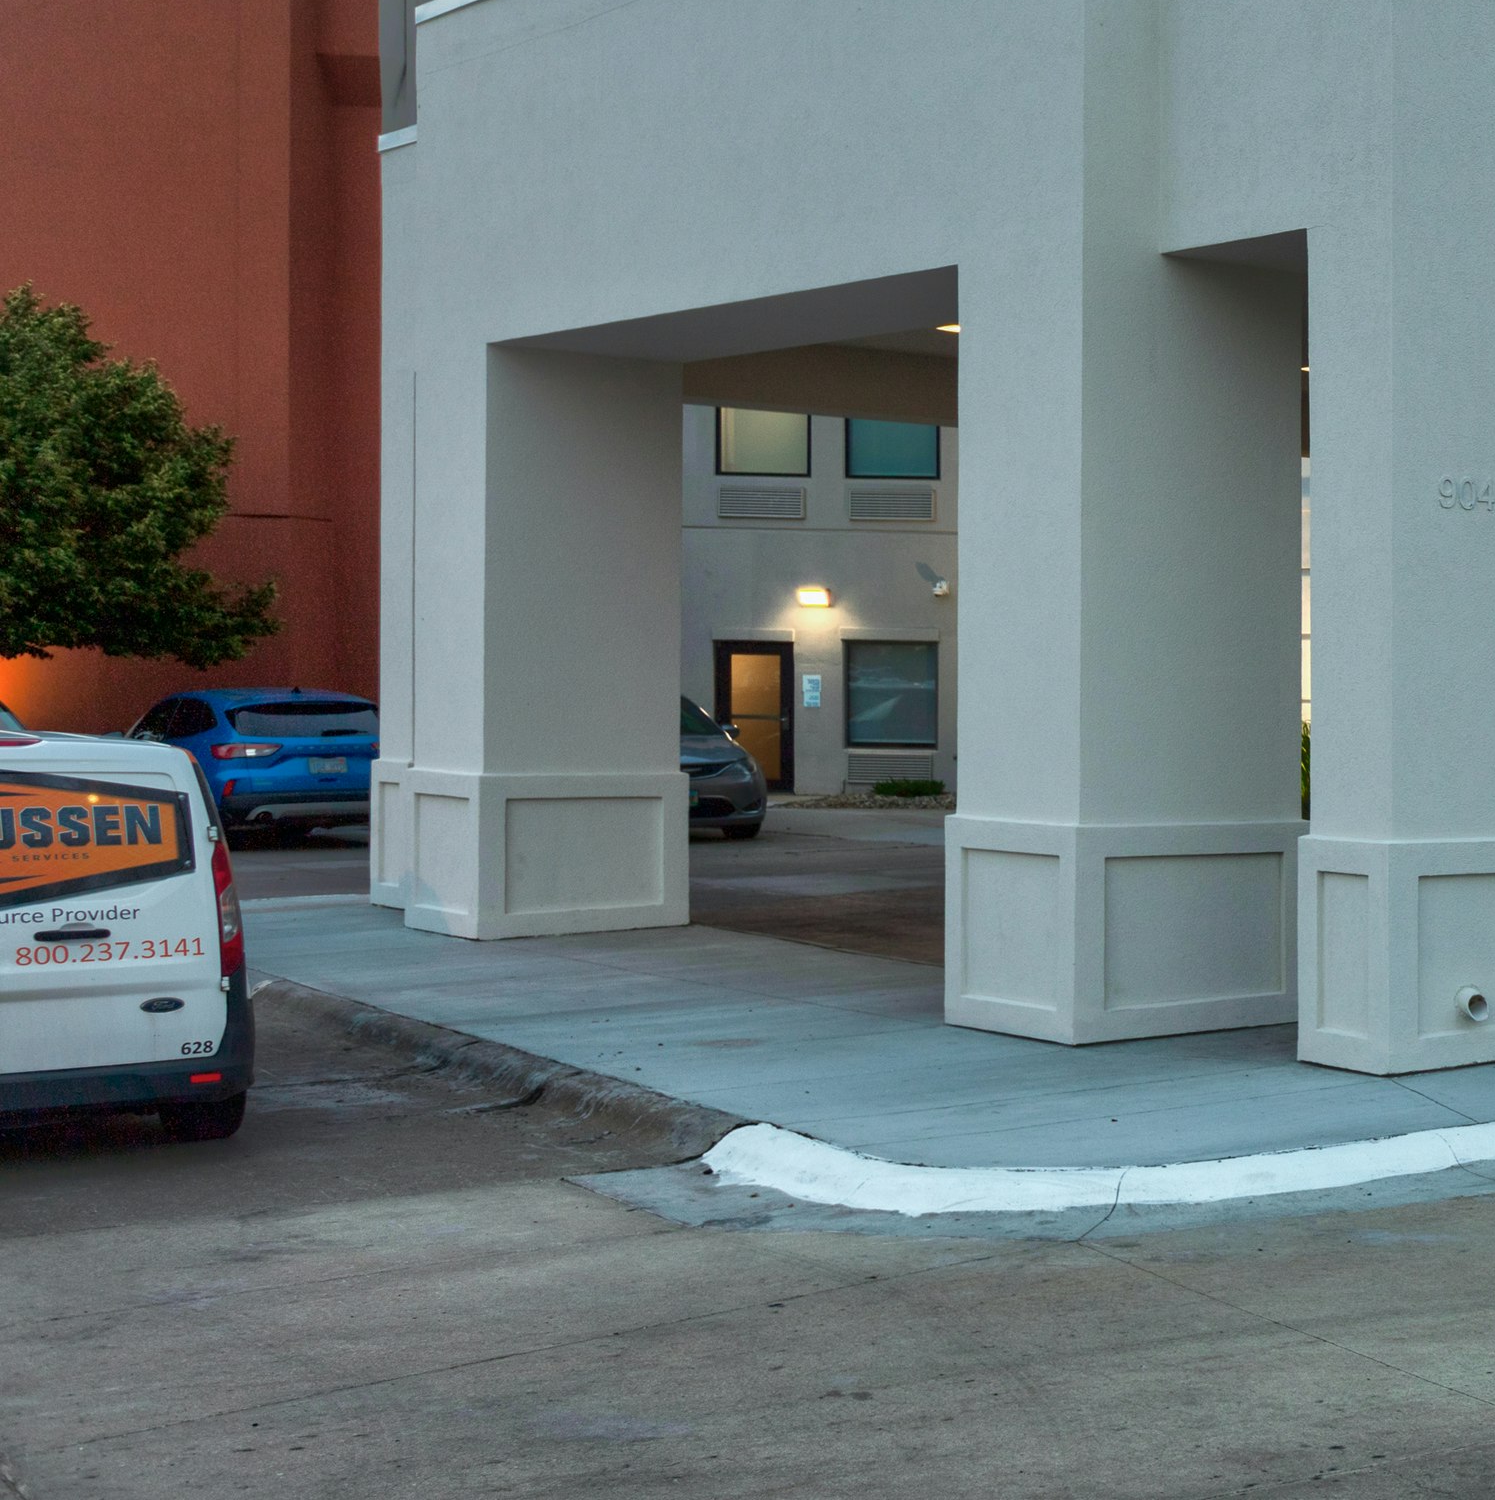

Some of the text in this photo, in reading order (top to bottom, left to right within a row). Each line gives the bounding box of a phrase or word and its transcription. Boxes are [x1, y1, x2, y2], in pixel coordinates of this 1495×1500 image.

[12, 852, 90, 862] SERVICES
[52, 905, 140, 922] Provider
[15, 937, 205, 966] 800.237.3141
[181, 1040, 213, 1055] 628
